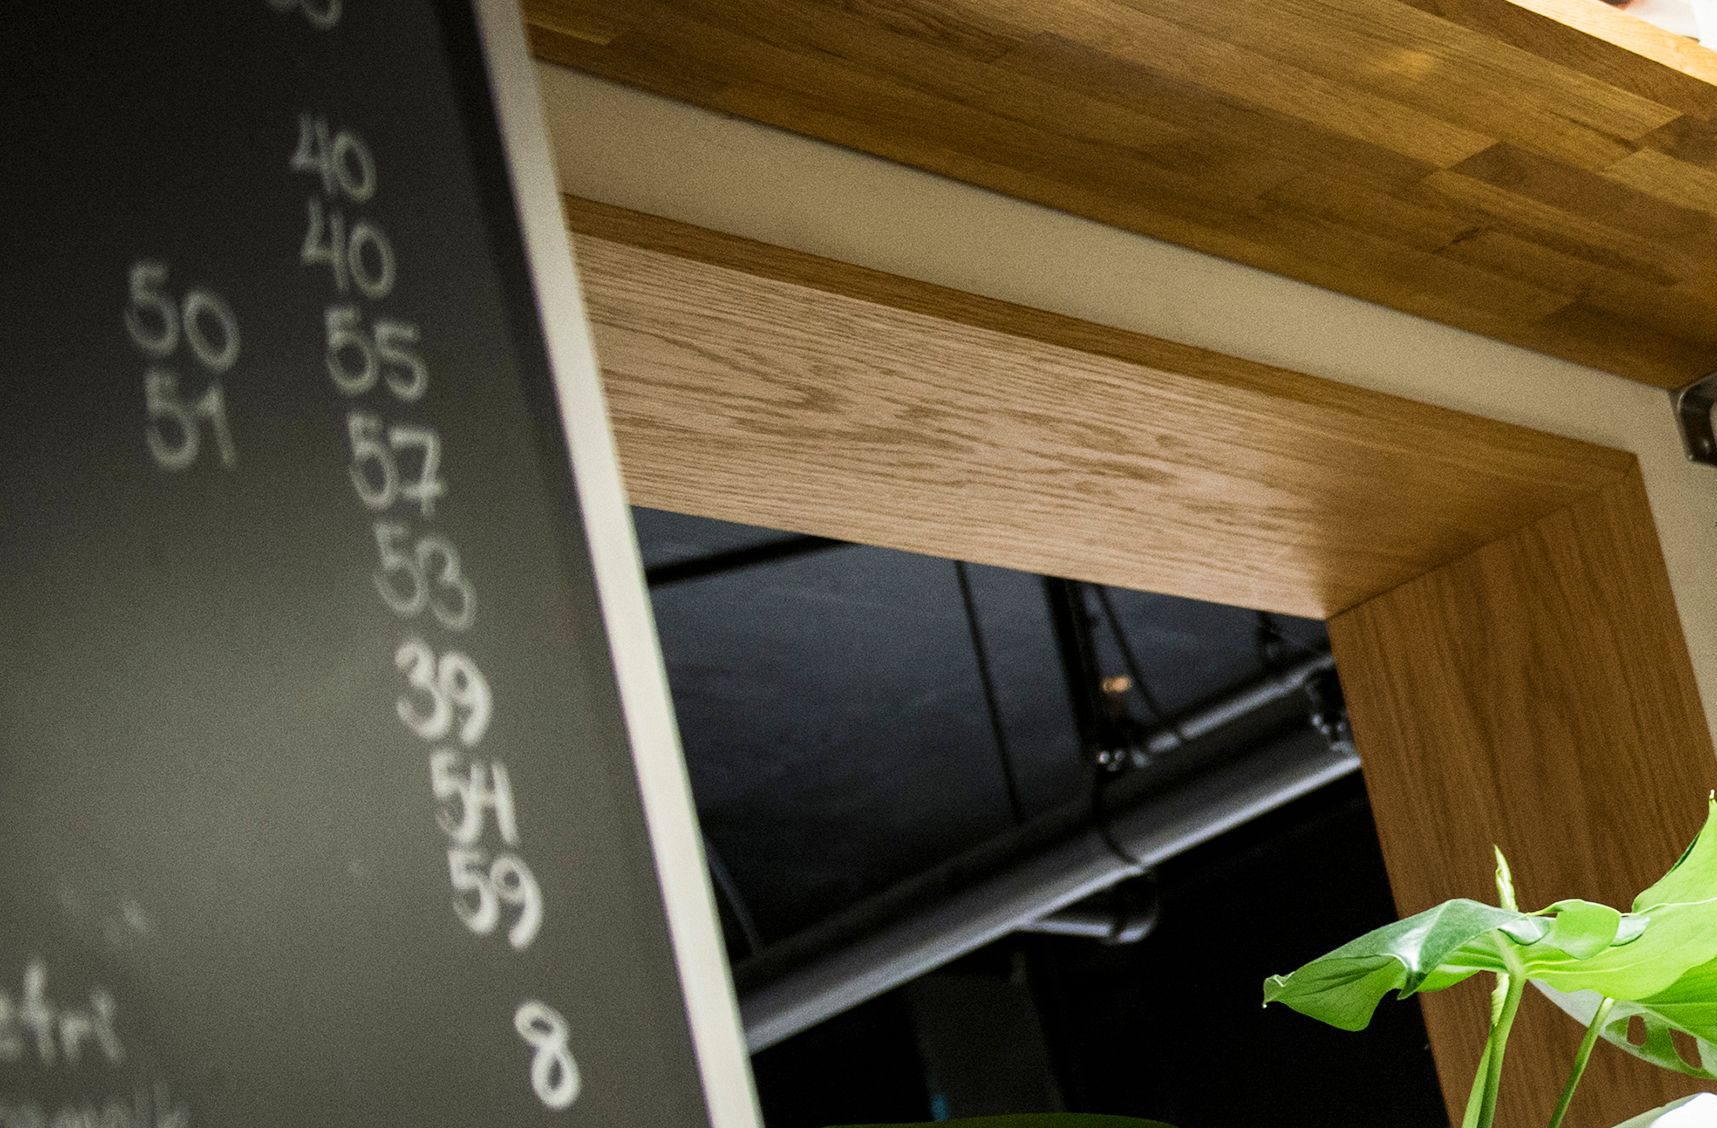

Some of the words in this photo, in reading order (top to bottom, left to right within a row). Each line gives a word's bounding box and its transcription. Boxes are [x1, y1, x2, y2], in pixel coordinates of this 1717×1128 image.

[290, 112, 378, 200] 40
[302, 200, 396, 297] 40
[125, 260, 241, 372] 50
[325, 306, 428, 400] 55
[146, 370, 236, 468] 51
[347, 412, 446, 517] 57
[372, 522, 476, 630] 53
[395, 637, 492, 744] 39
[430, 752, 520, 843] 54
[448, 848, 543, 948] 59
[515, 1000, 582, 1109] 8
